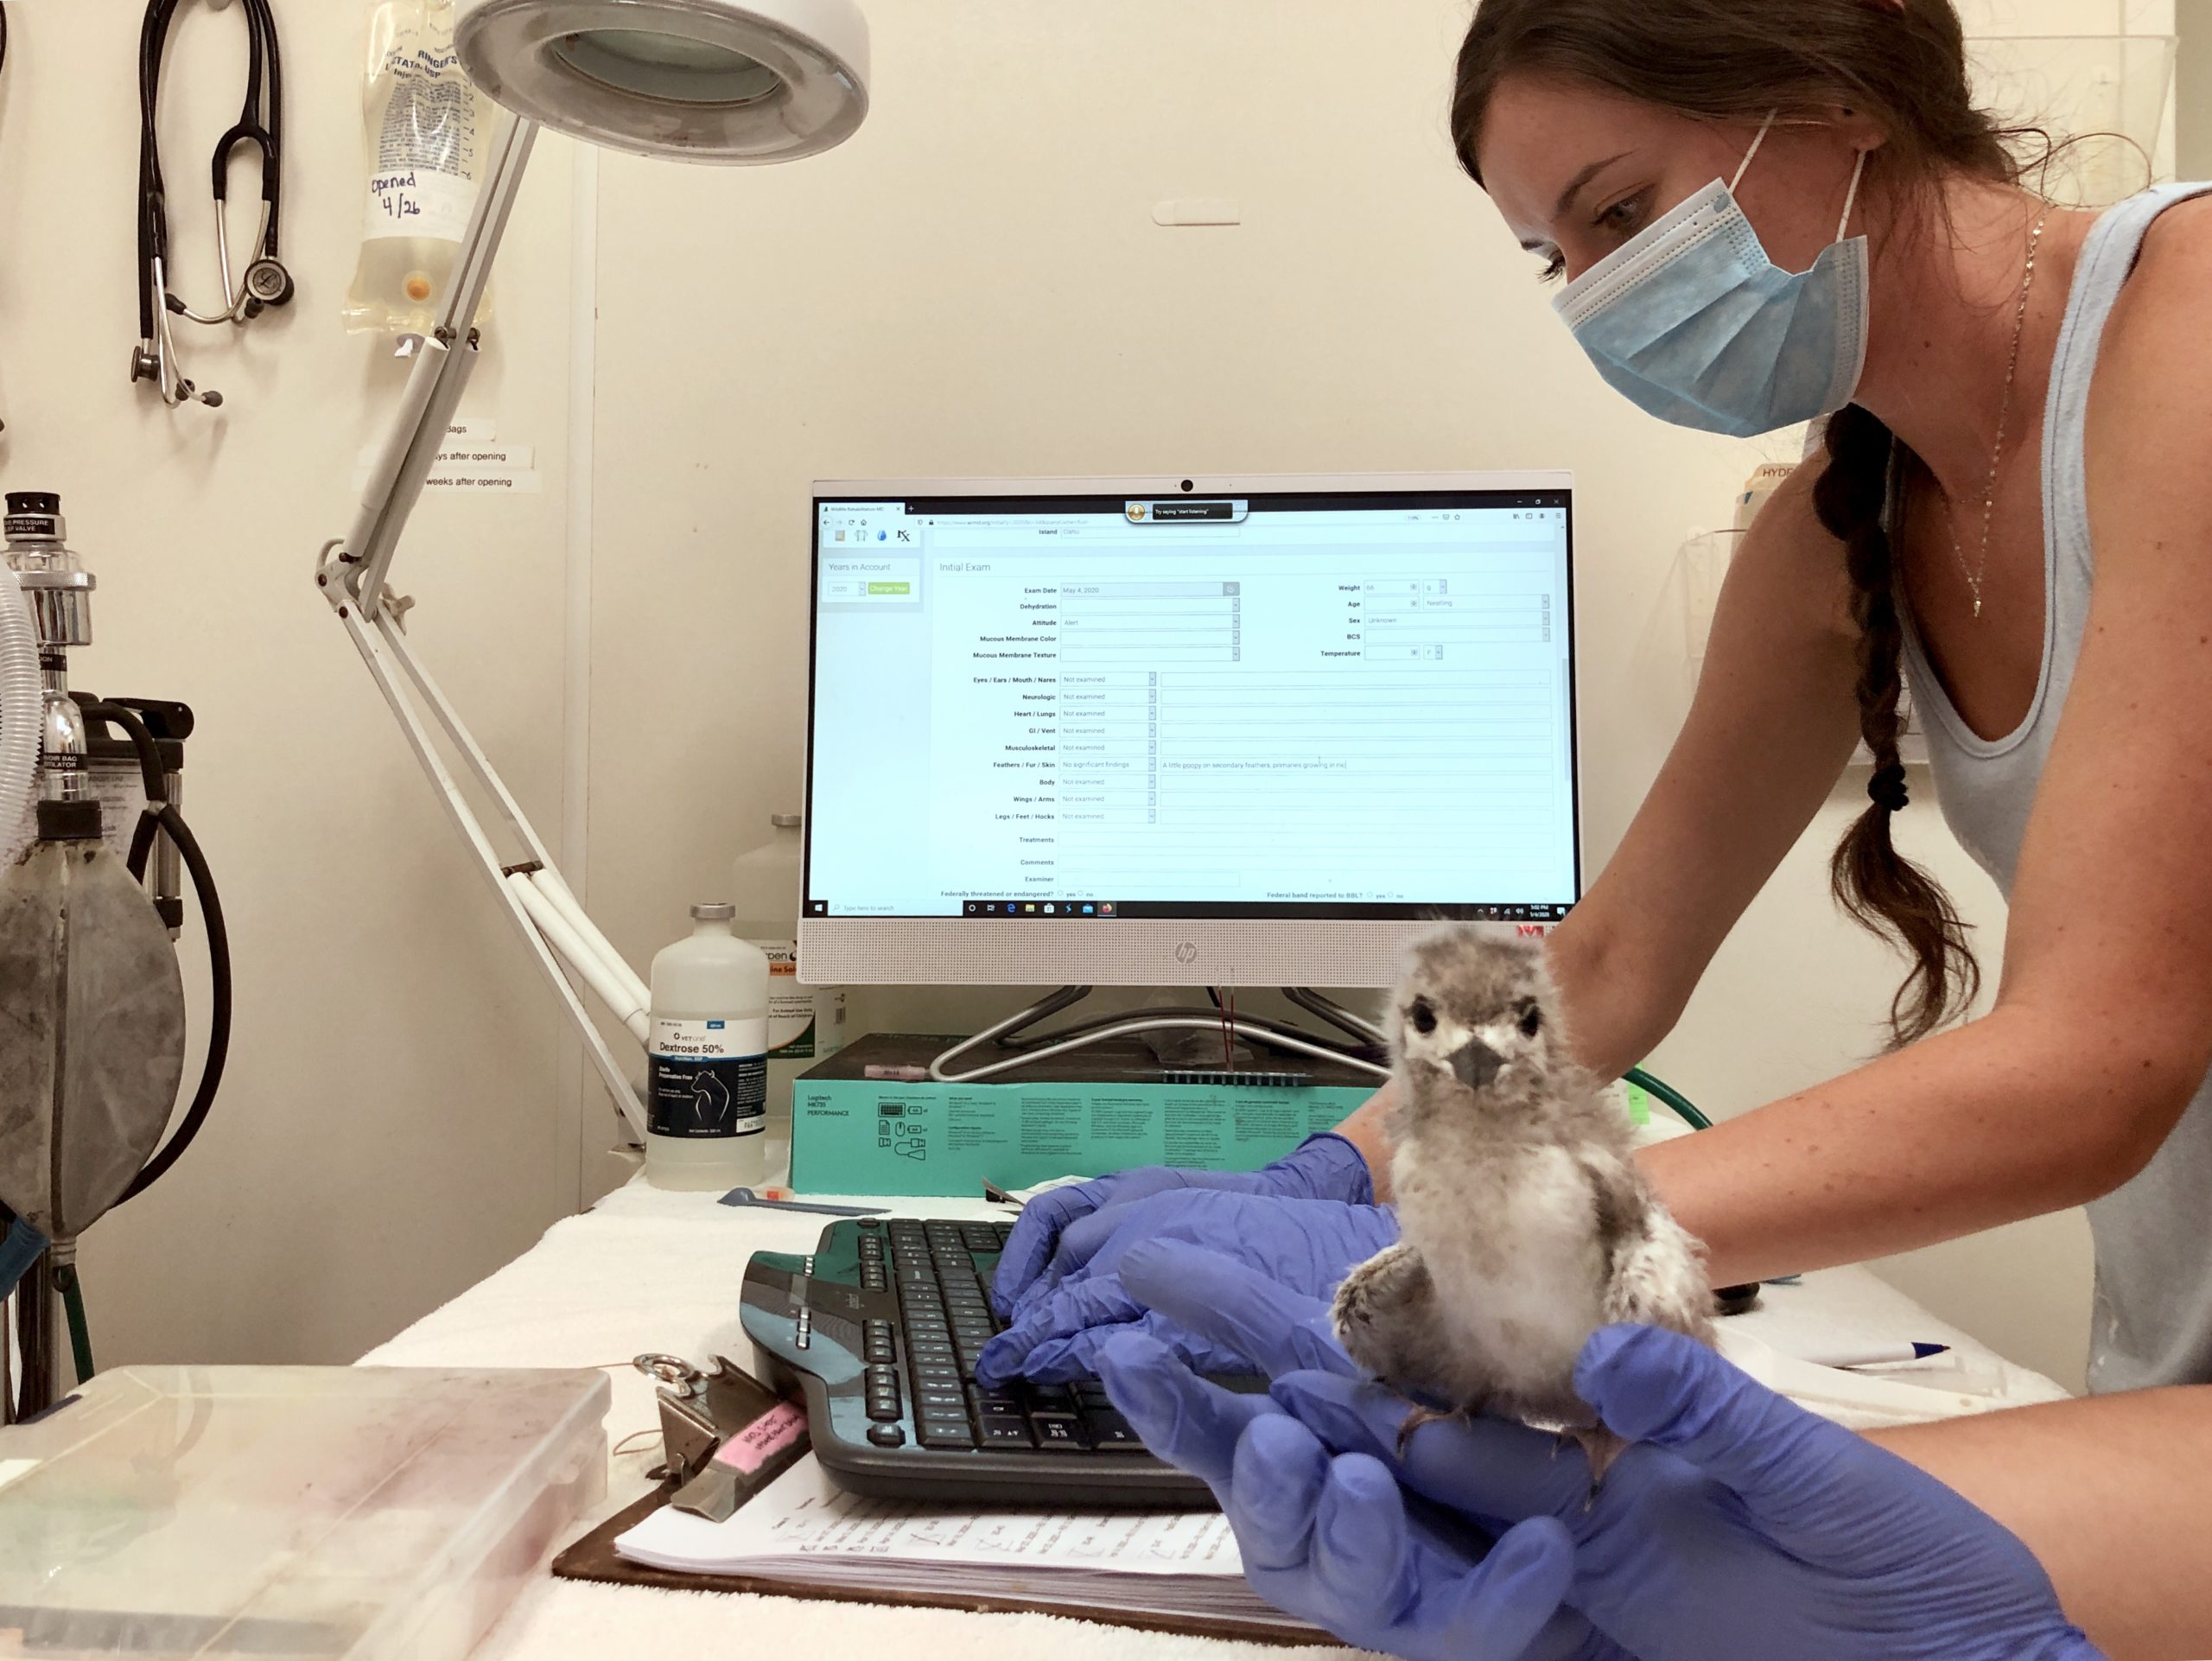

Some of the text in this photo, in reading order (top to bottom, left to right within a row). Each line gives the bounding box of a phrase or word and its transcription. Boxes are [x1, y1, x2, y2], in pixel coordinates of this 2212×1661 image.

[383, 193, 420, 219] 4/26
[450, 452, 470, 461] after
[471, 452, 506, 461] opening
[478, 478, 512, 487] opening
[939, 563, 991, 572] Initial Exam
[1020, 602, 1058, 611] Dehydration
[973, 676, 988, 684] Eyes
[1022, 693, 1057, 702] Neurologic
[1073, 760, 1104, 769] significant
[1105, 760, 1130, 769] findings
[995, 812, 1009, 821] Legs
[940, 890, 969, 899] Federally
[1014, 890, 1054, 899] endangered?
[660, 1042, 724, 1053] Dextrose 50%
